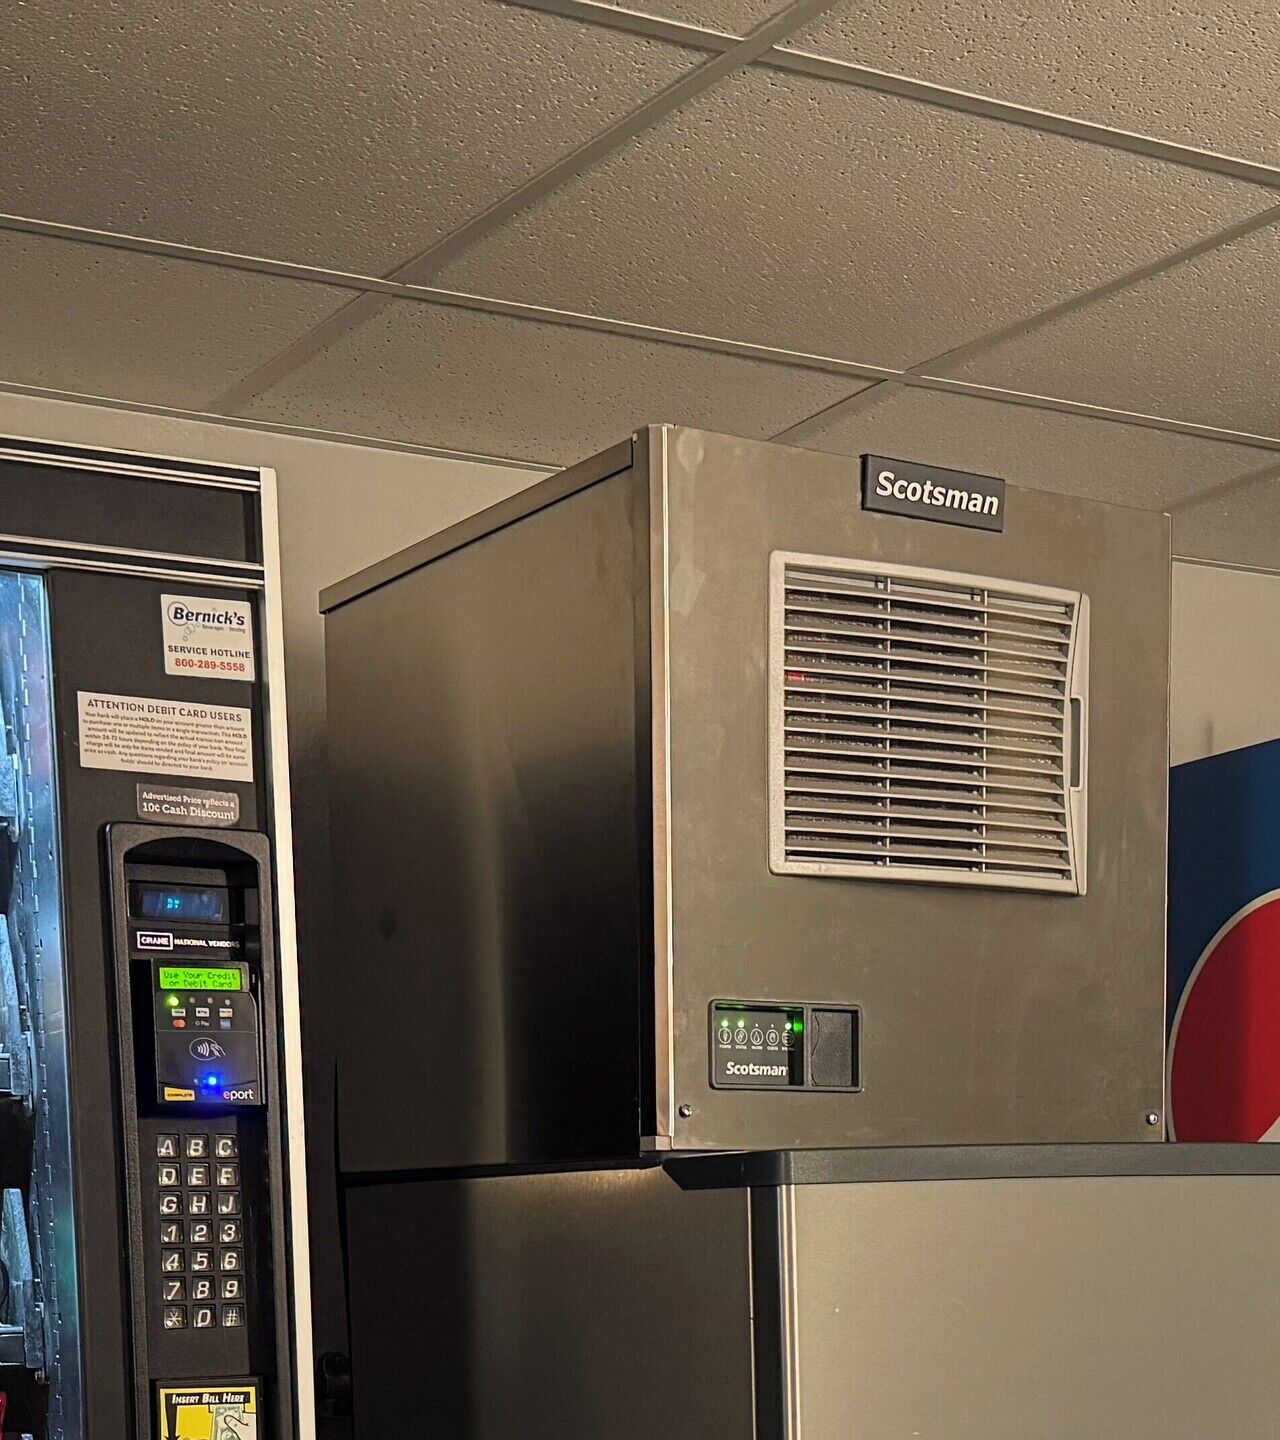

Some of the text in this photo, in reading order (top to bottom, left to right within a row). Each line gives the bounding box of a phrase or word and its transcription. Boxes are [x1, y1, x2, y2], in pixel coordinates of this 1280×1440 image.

[875, 470, 999, 515] Scotsman
[173, 607, 245, 626] Bernick's
[168, 645, 251, 658] SERVICE HOTLINE
[175, 658, 245, 672] 800-289-5558
[87, 699, 242, 722] ATTENTION DEBIT CARD USERS
[142, 791, 181, 802] Advertised
[183, 795, 201, 804] Price
[142, 802, 235, 820] 10¢ Cash Discount
[141, 936, 169, 945] CRANE
[174, 938, 208, 947] NATIONAL
[164, 971, 179, 979] Use
[207, 972, 237, 980] Credit
[726, 1061, 787, 1076] Scotsman
[223, 1089, 254, 1101] eport
[163, 1139, 232, 1156] A B C
[164, 1168, 233, 1184] D E F
[163, 1196, 234, 1213] G H J
[167, 1224, 236, 1241] 1 2 3
[166, 1252, 238, 1270] 4 5 6
[168, 1280, 238, 1300] 7 8 9
[202, 1393, 220, 1403] BILL
